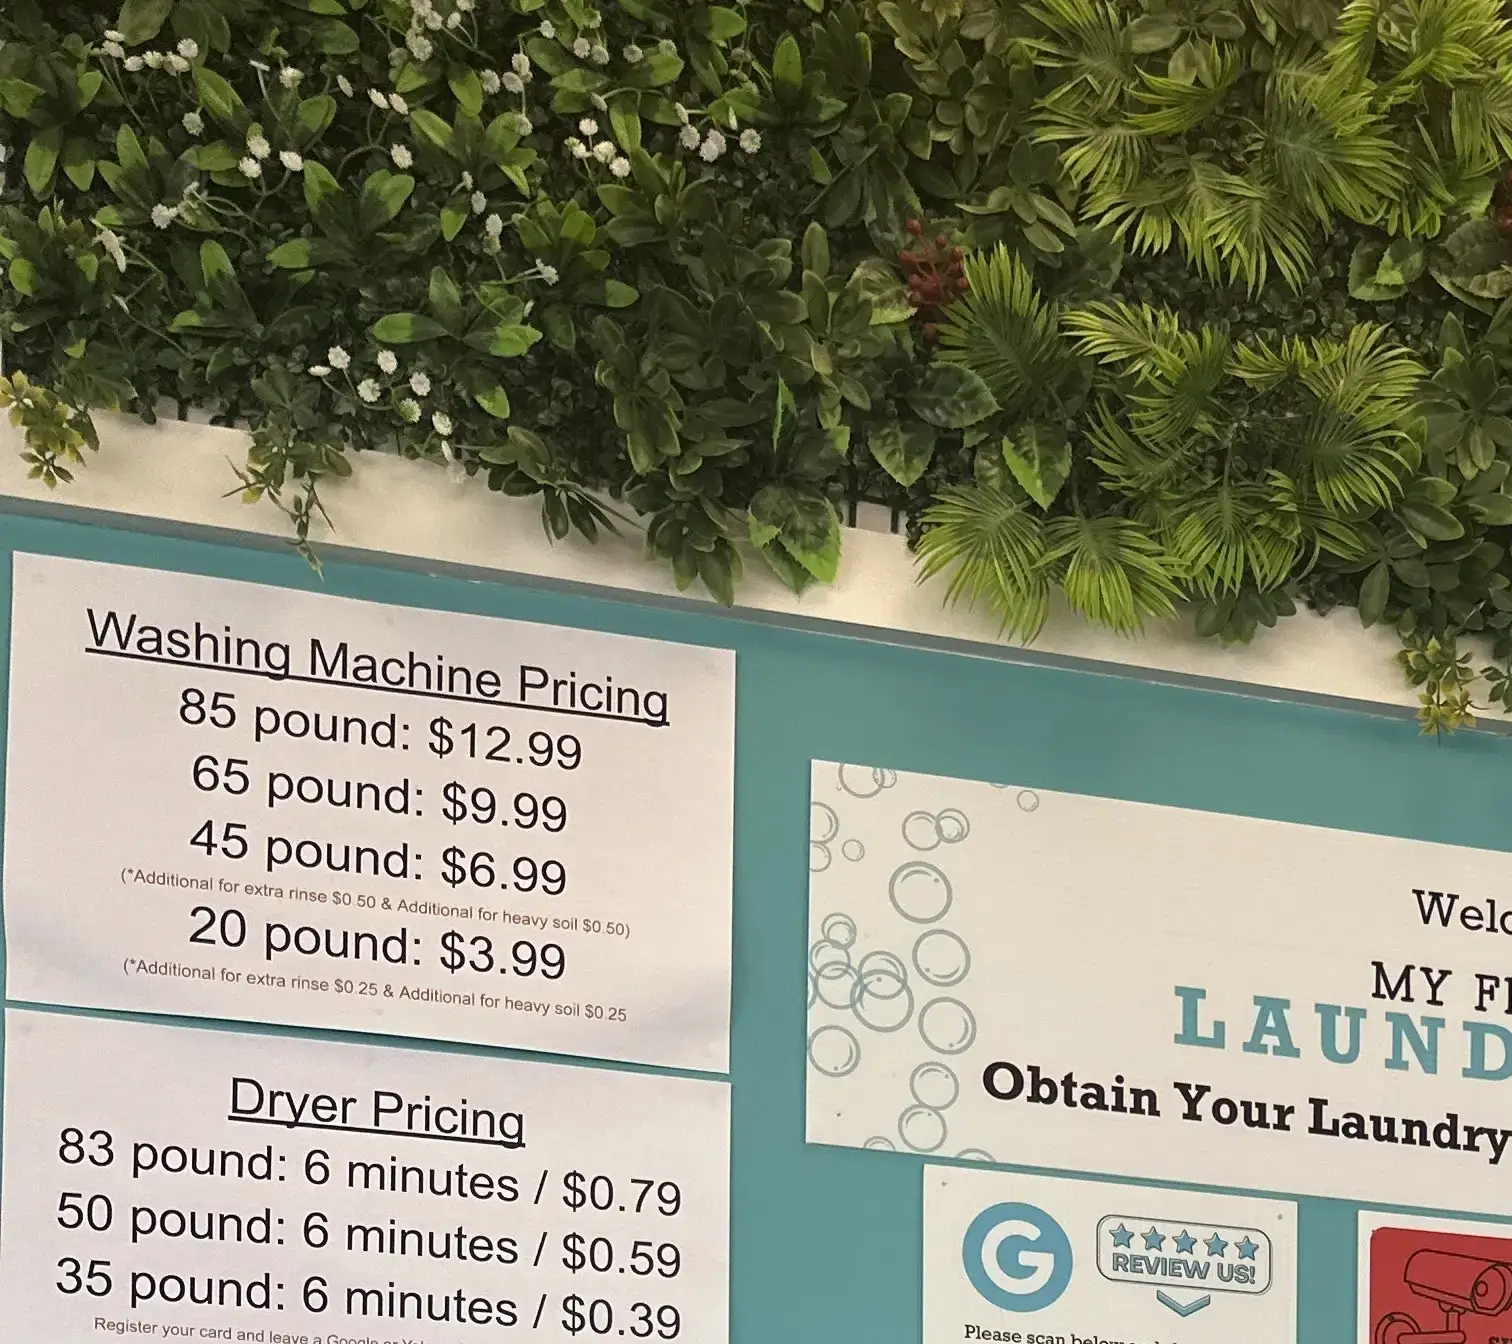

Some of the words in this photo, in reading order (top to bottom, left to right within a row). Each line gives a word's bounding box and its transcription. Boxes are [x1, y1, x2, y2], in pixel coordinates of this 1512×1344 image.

[87, 608, 291, 680] Washing
[309, 640, 502, 699] Machine
[520, 665, 670, 725] Pricing
[179, 687, 237, 729] 85
[254, 705, 410, 751] pound:
[428, 715, 582, 771] $12.99
[192, 754, 250, 795] 65
[268, 772, 423, 817] pound:
[441, 780, 567, 833] $9.99
[1370, 960, 1453, 1007] MY
[230, 1077, 356, 1128] Dryer
[374, 1090, 526, 1147] Pricing
[982, 1061, 1161, 1118] Obtain
[1173, 1081, 1296, 1132] Your
[1307, 1097, 1512, 1166] Laundry
[58, 1127, 115, 1167] 83
[132, 1142, 286, 1182] pound:
[304, 1149, 330, 1186] 6
[348, 1155, 519, 1203] minutes
[533, 1169, 549, 1205] /
[562, 1169, 681, 1217] $0.79
[1112, 1252, 1210, 1280] REVIEW
[1217, 1264, 1255, 1284] US!
[964, 1324, 1022, 1344] Please
